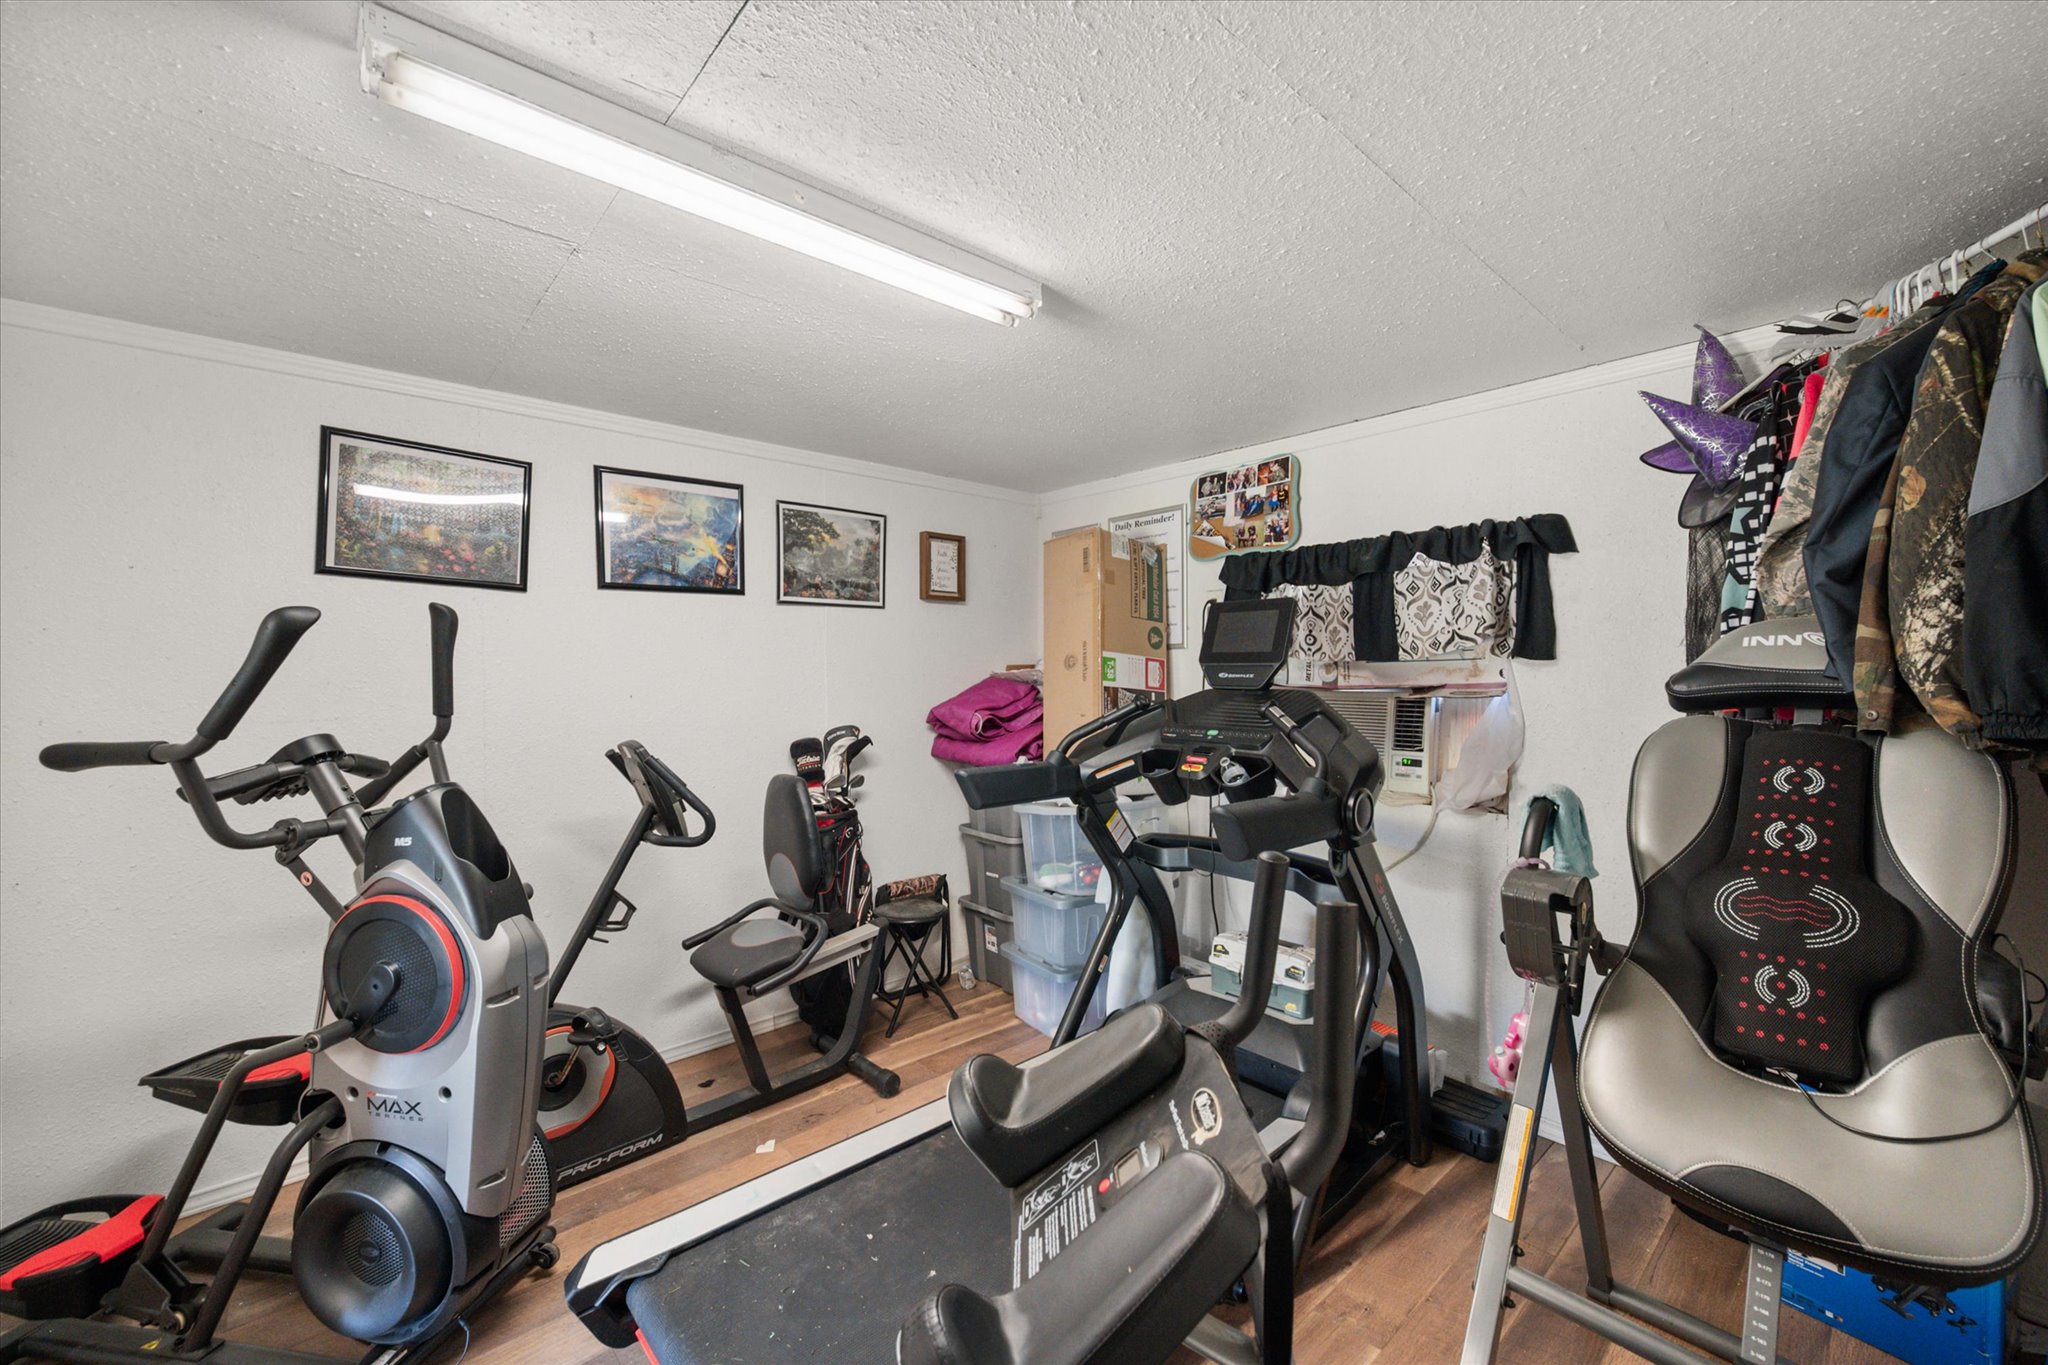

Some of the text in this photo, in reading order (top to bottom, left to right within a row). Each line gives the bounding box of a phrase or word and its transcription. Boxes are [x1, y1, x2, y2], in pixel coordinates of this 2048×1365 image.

[1114, 513, 1175, 532] Daily Reminder!
[394, 837, 413, 847] M5
[1382, 894, 1404, 944] BOWFLEX
[367, 1096, 422, 1116] MAX
[556, 1133, 664, 1181] PRO-FORM
